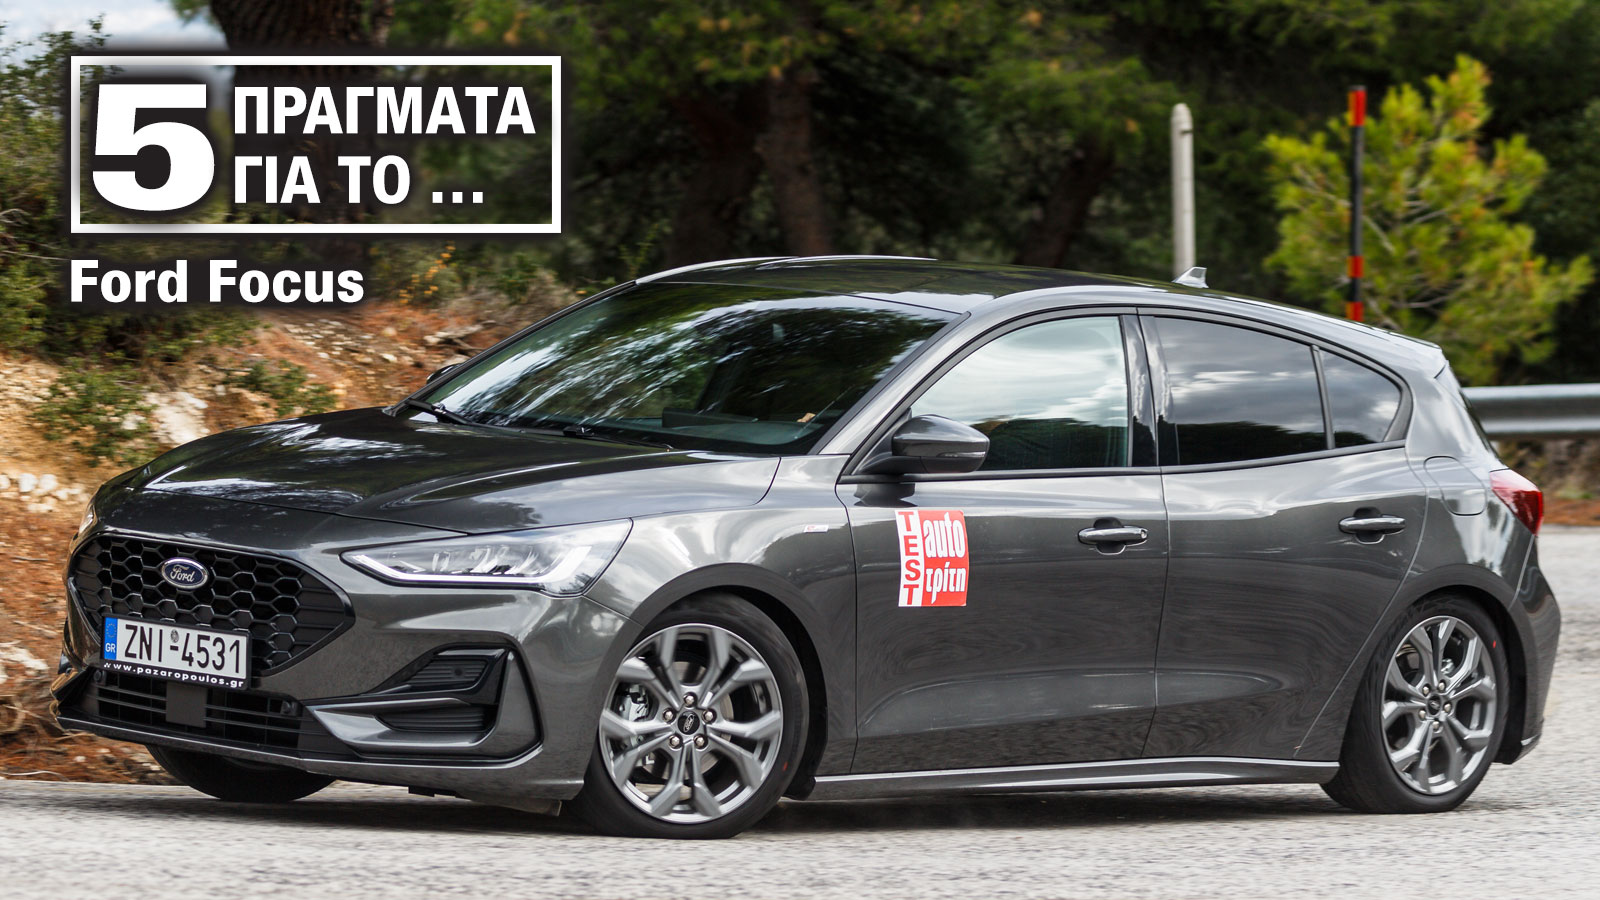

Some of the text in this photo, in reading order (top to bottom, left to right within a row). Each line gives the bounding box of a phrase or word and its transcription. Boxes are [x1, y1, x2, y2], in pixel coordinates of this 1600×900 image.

[923, 512, 965, 558] auto
[170, 564, 195, 582] Ford
[898, 511, 921, 605] TEST
[105, 642, 116, 654] GR
[124, 623, 240, 674] ZNI-4531
[103, 661, 244, 689] www.pazaropoulos.gr
